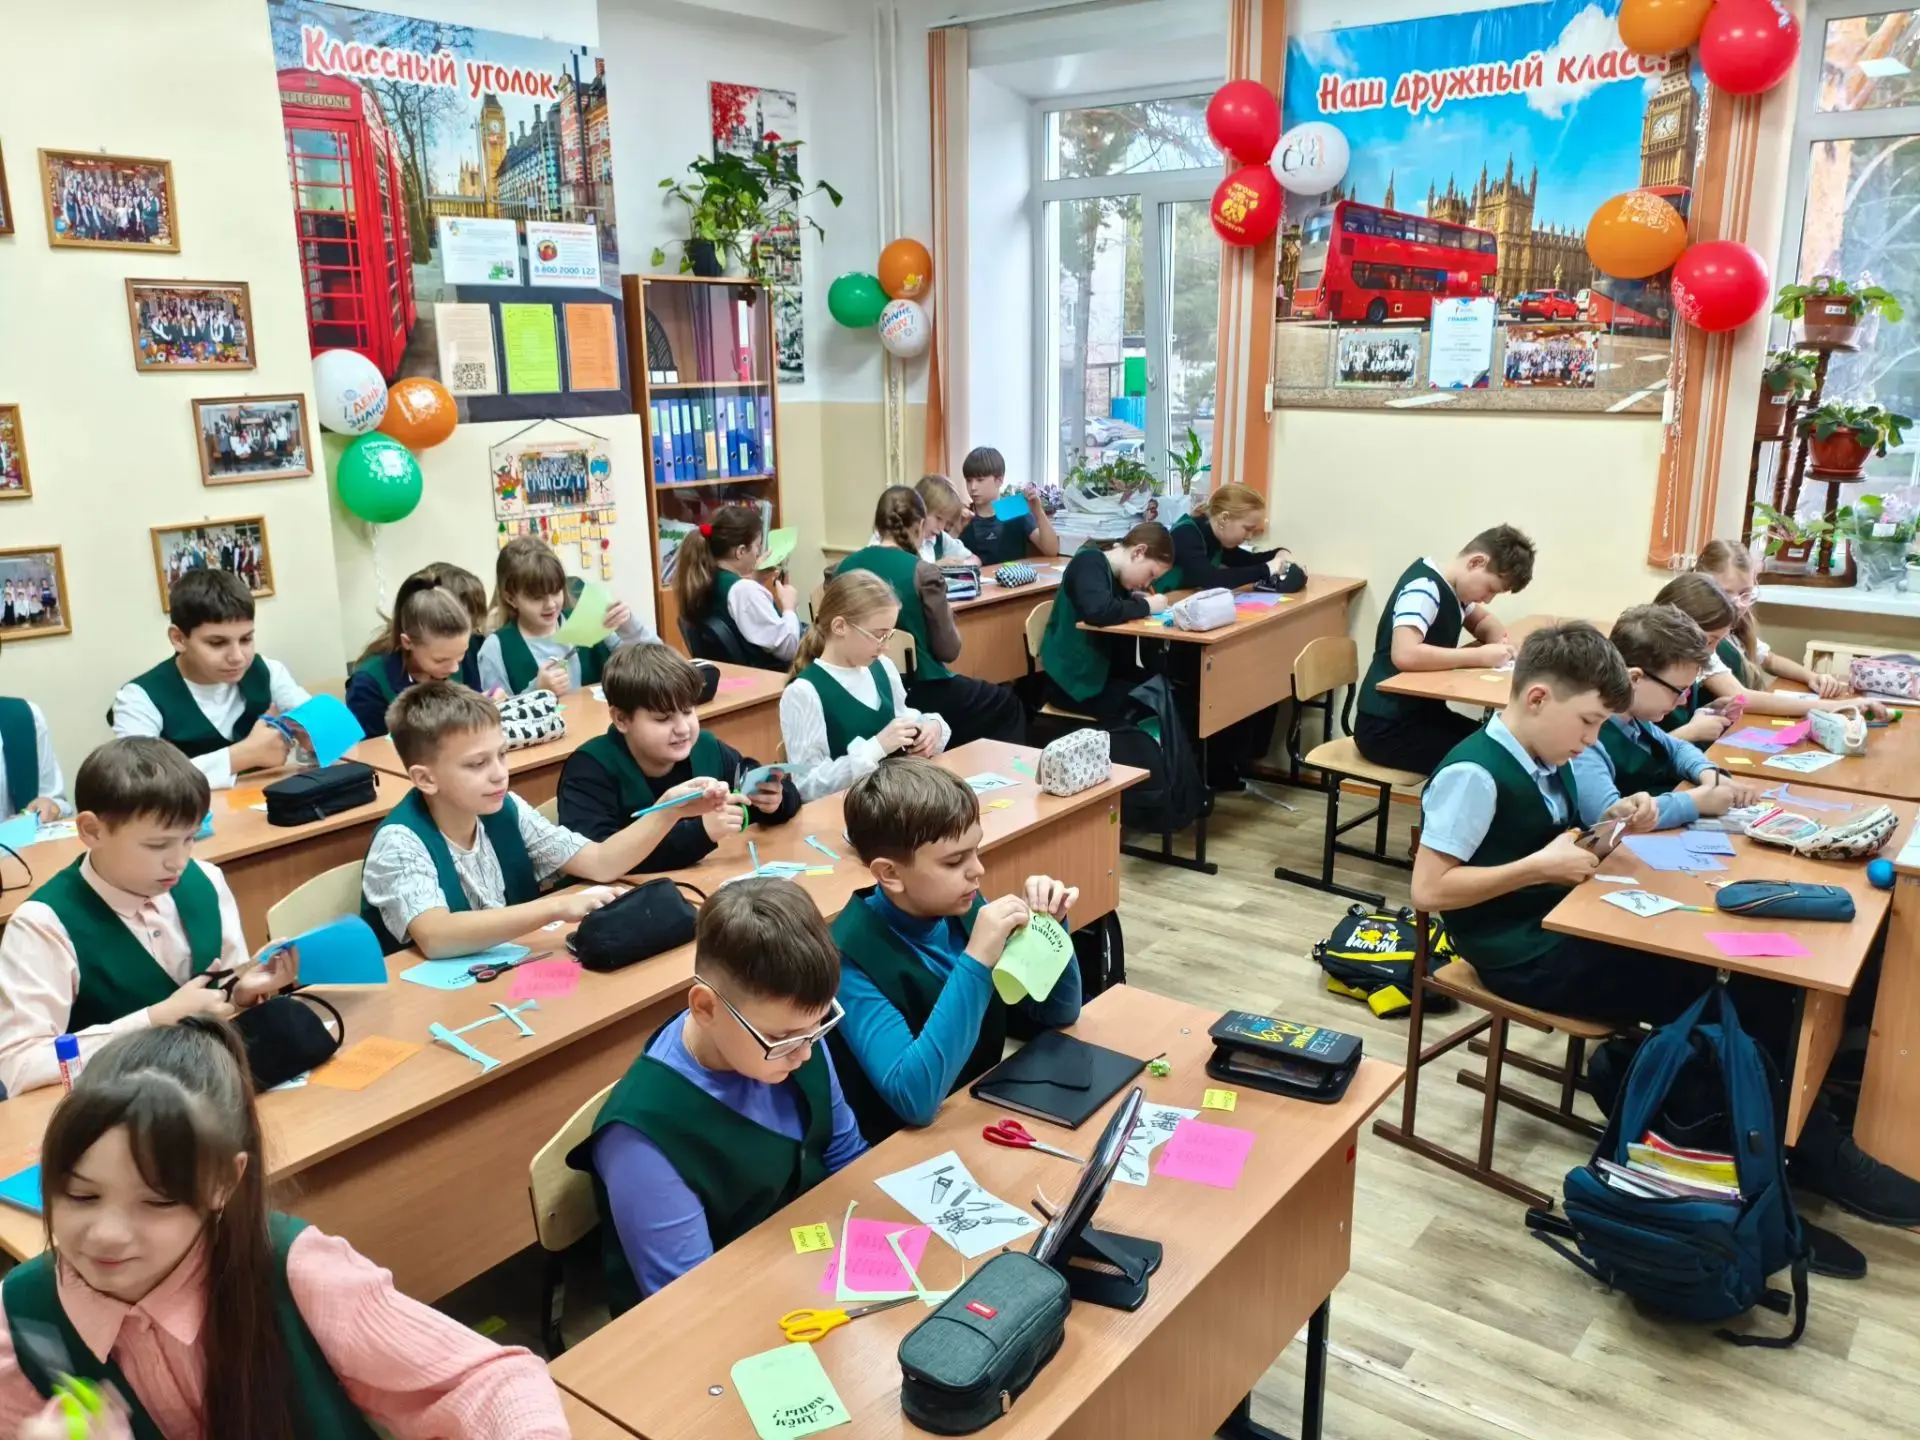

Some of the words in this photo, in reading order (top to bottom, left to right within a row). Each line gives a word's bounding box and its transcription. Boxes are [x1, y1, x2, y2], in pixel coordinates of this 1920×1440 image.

[304, 27, 457, 86] Классный
[467, 64, 556, 99] уголок
[1319, 76, 1384, 110] Наш
[1394, 56, 1544, 112] дружный
[582, 267, 597, 276] 122
[775, 1410, 821, 1429] Днём
[821, 1404, 835, 1416] С
